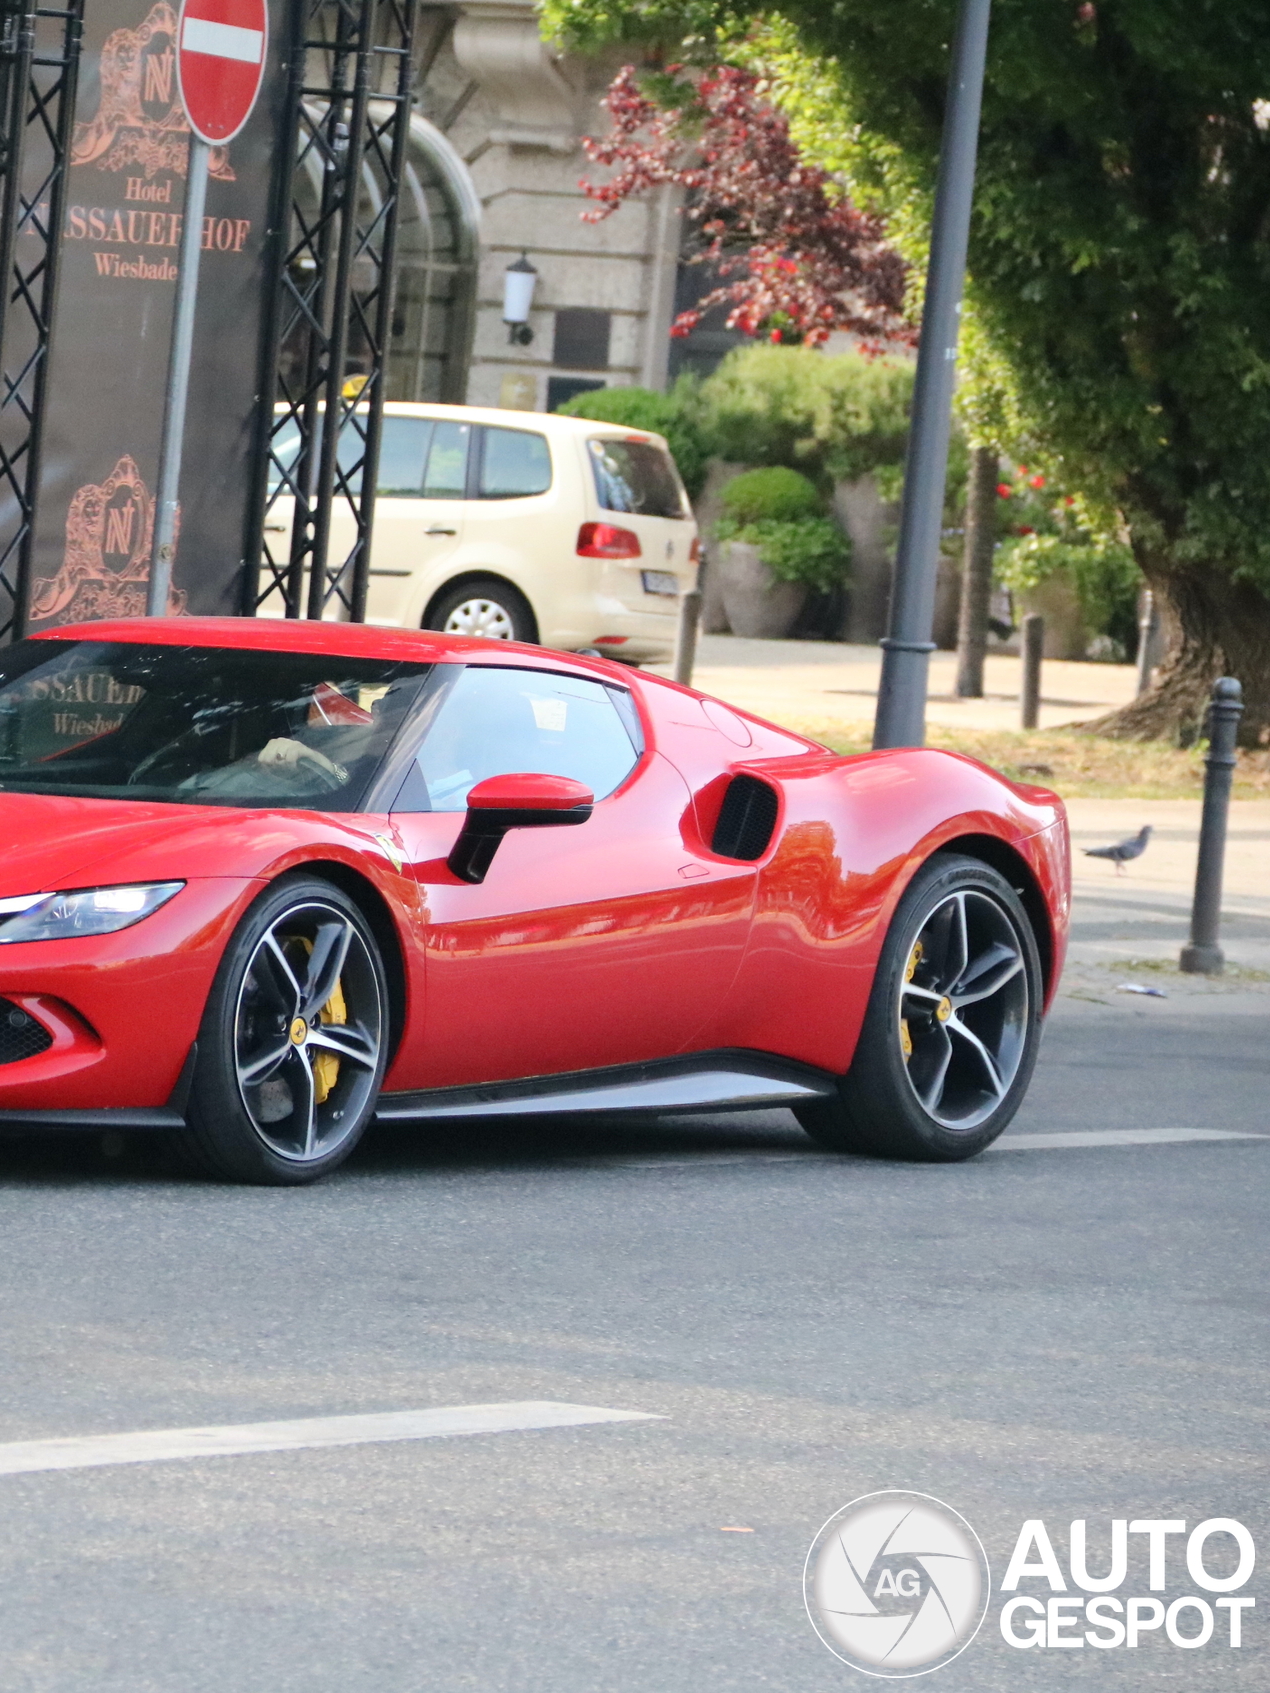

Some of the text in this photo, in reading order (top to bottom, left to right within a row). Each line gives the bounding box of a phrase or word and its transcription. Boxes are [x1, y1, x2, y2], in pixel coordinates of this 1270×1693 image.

[124, 177, 172, 203] Hotel
[200, 216, 251, 252] HOF
[93, 252, 178, 281] Wiesbade
